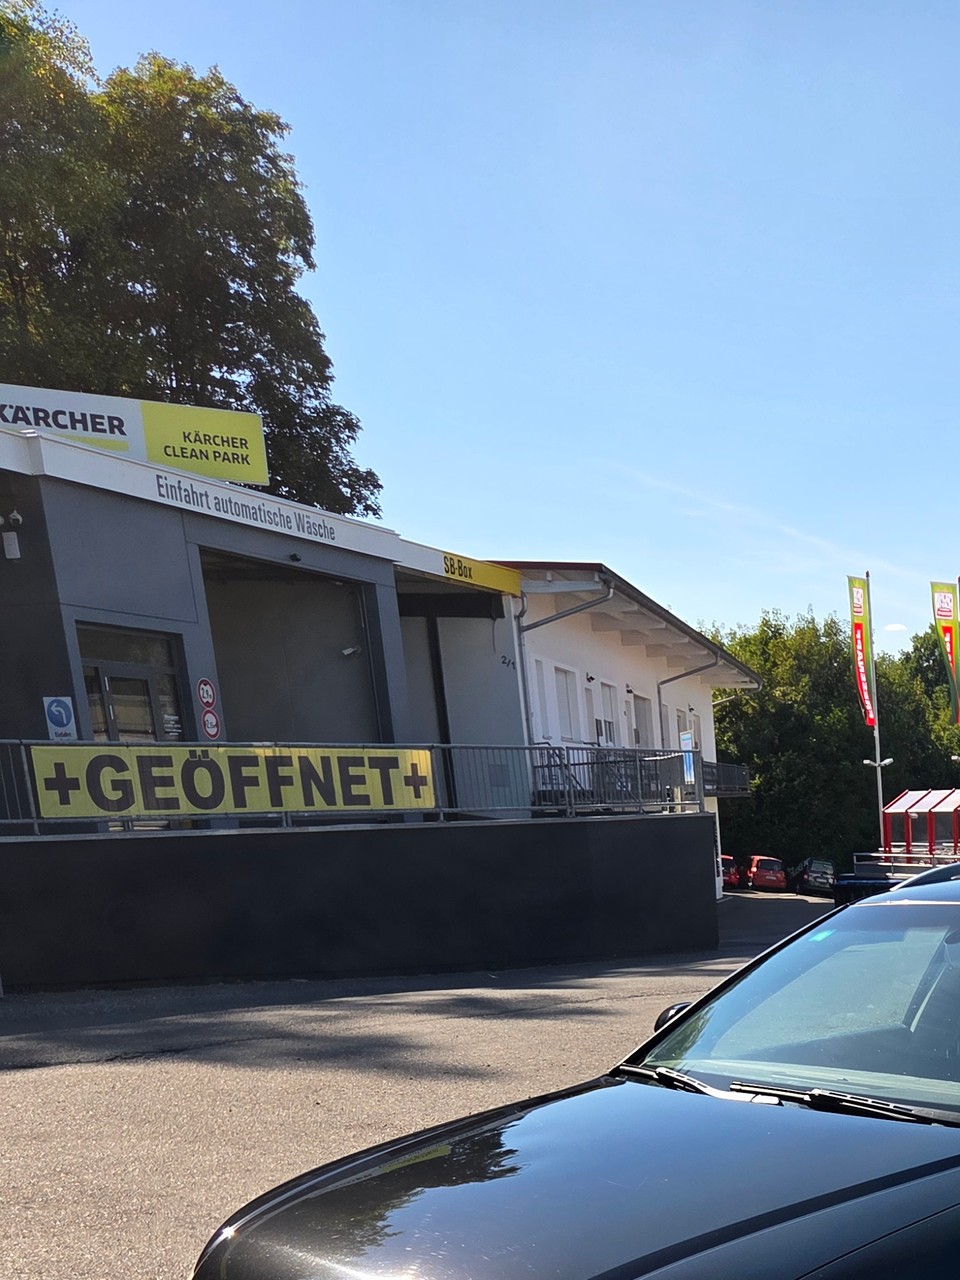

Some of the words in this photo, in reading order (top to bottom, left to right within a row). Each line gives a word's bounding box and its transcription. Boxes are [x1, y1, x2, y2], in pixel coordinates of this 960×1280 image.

[182, 430, 249, 450] KÄRCHER
[163, 445, 210, 461] CLEAN
[212, 450, 251, 466] PARK
[155, 474, 212, 510] Einfahrt
[213, 495, 293, 530] automatische
[293, 511, 336, 541] Wäsche
[443, 555, 473, 580] SB-Box
